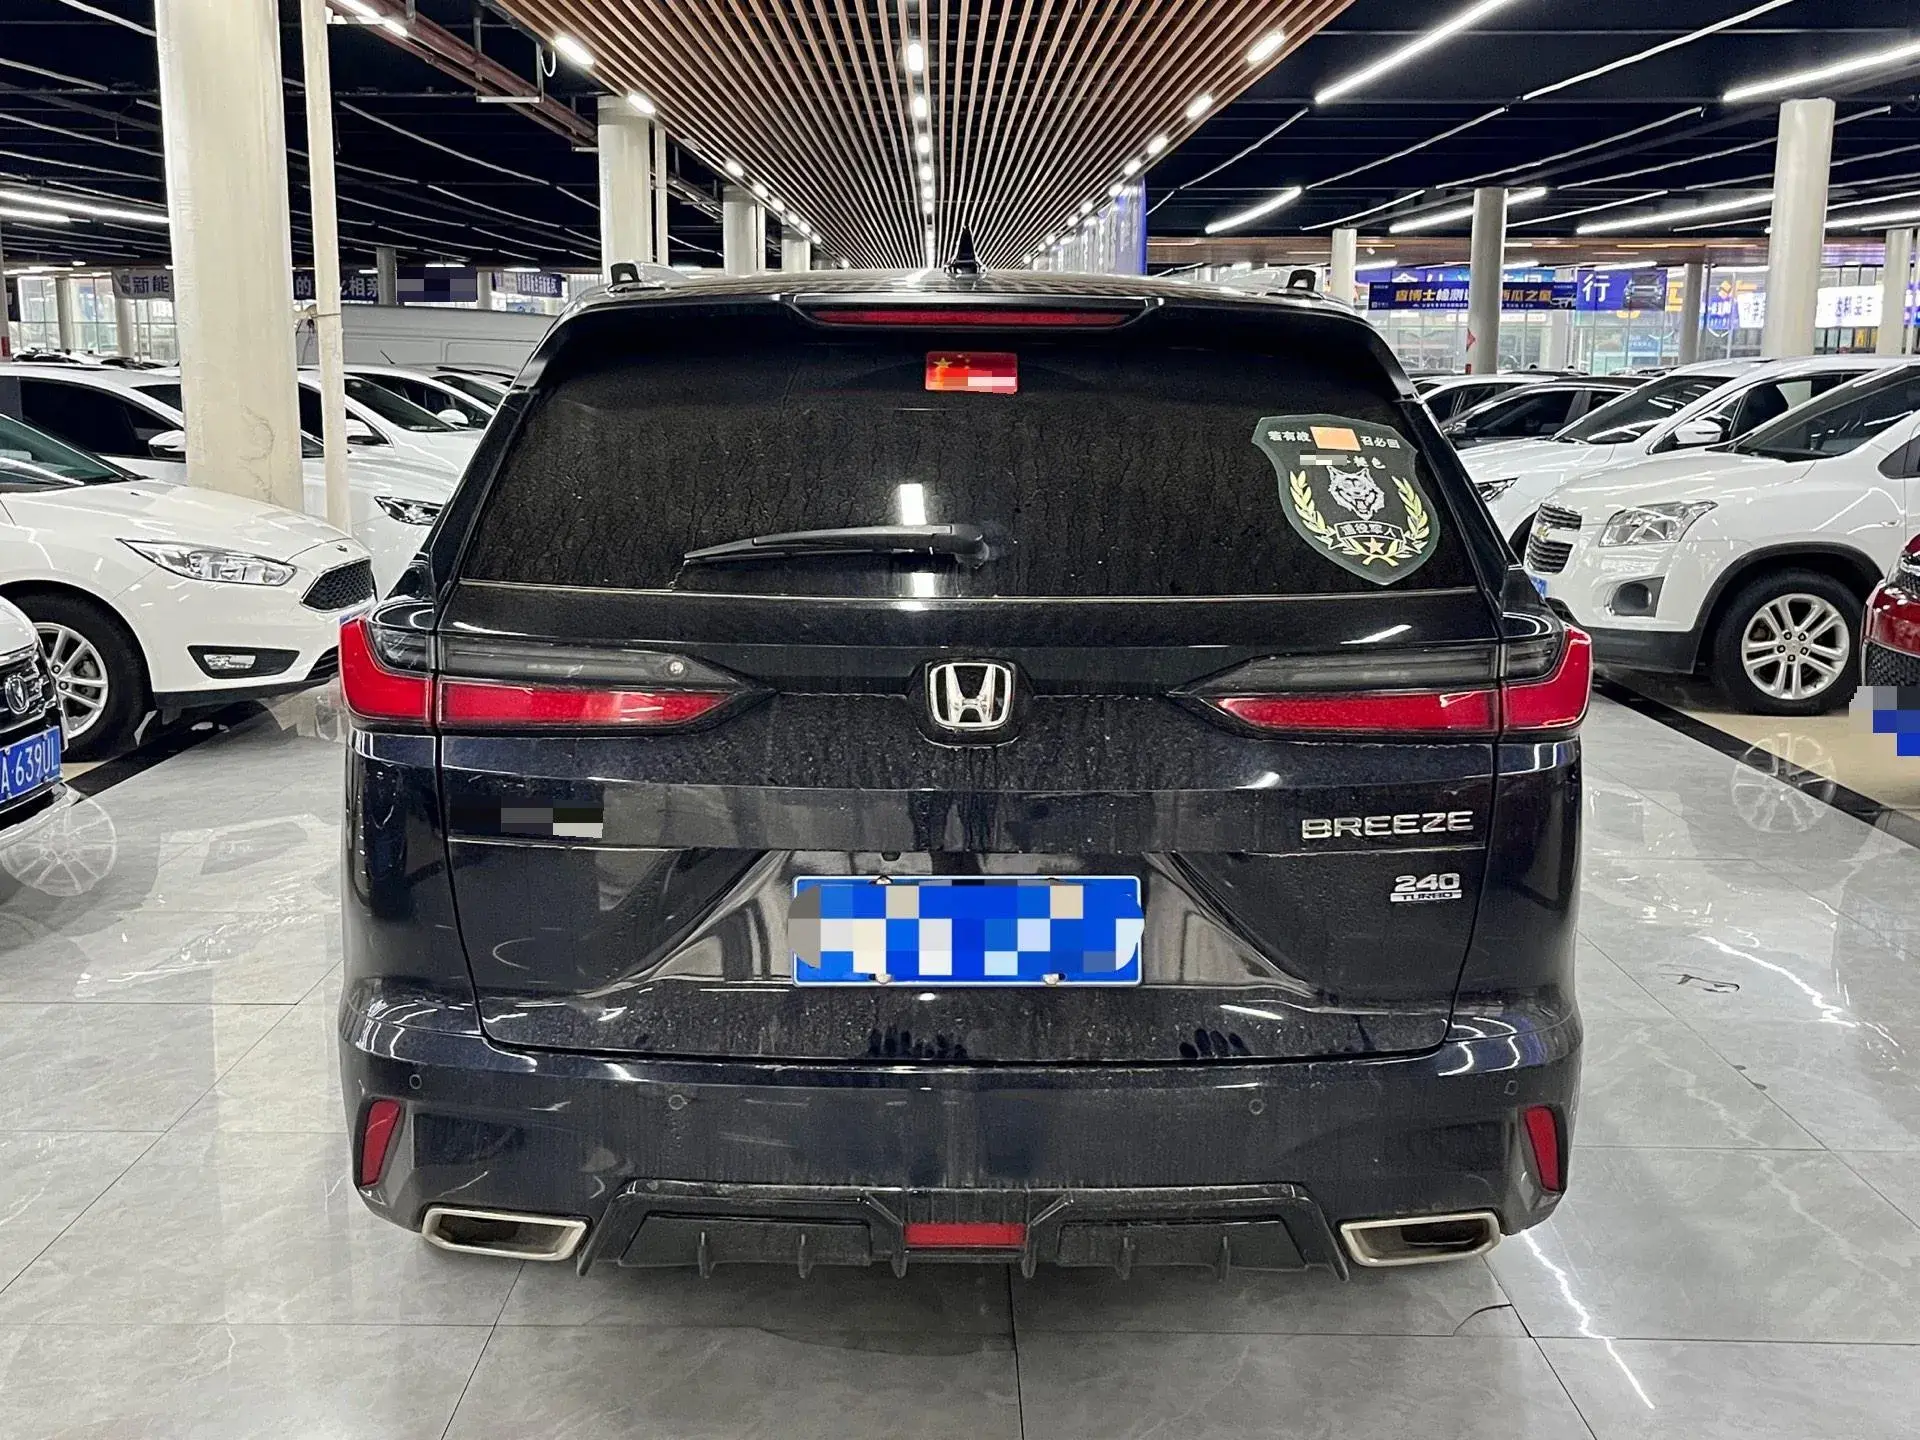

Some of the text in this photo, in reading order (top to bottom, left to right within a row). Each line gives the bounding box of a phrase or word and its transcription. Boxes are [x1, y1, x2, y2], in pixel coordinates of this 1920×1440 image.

[1582, 273, 1610, 301] 行
[1302, 811, 1473, 839] BREEZE
[1395, 873, 1460, 892] 240
